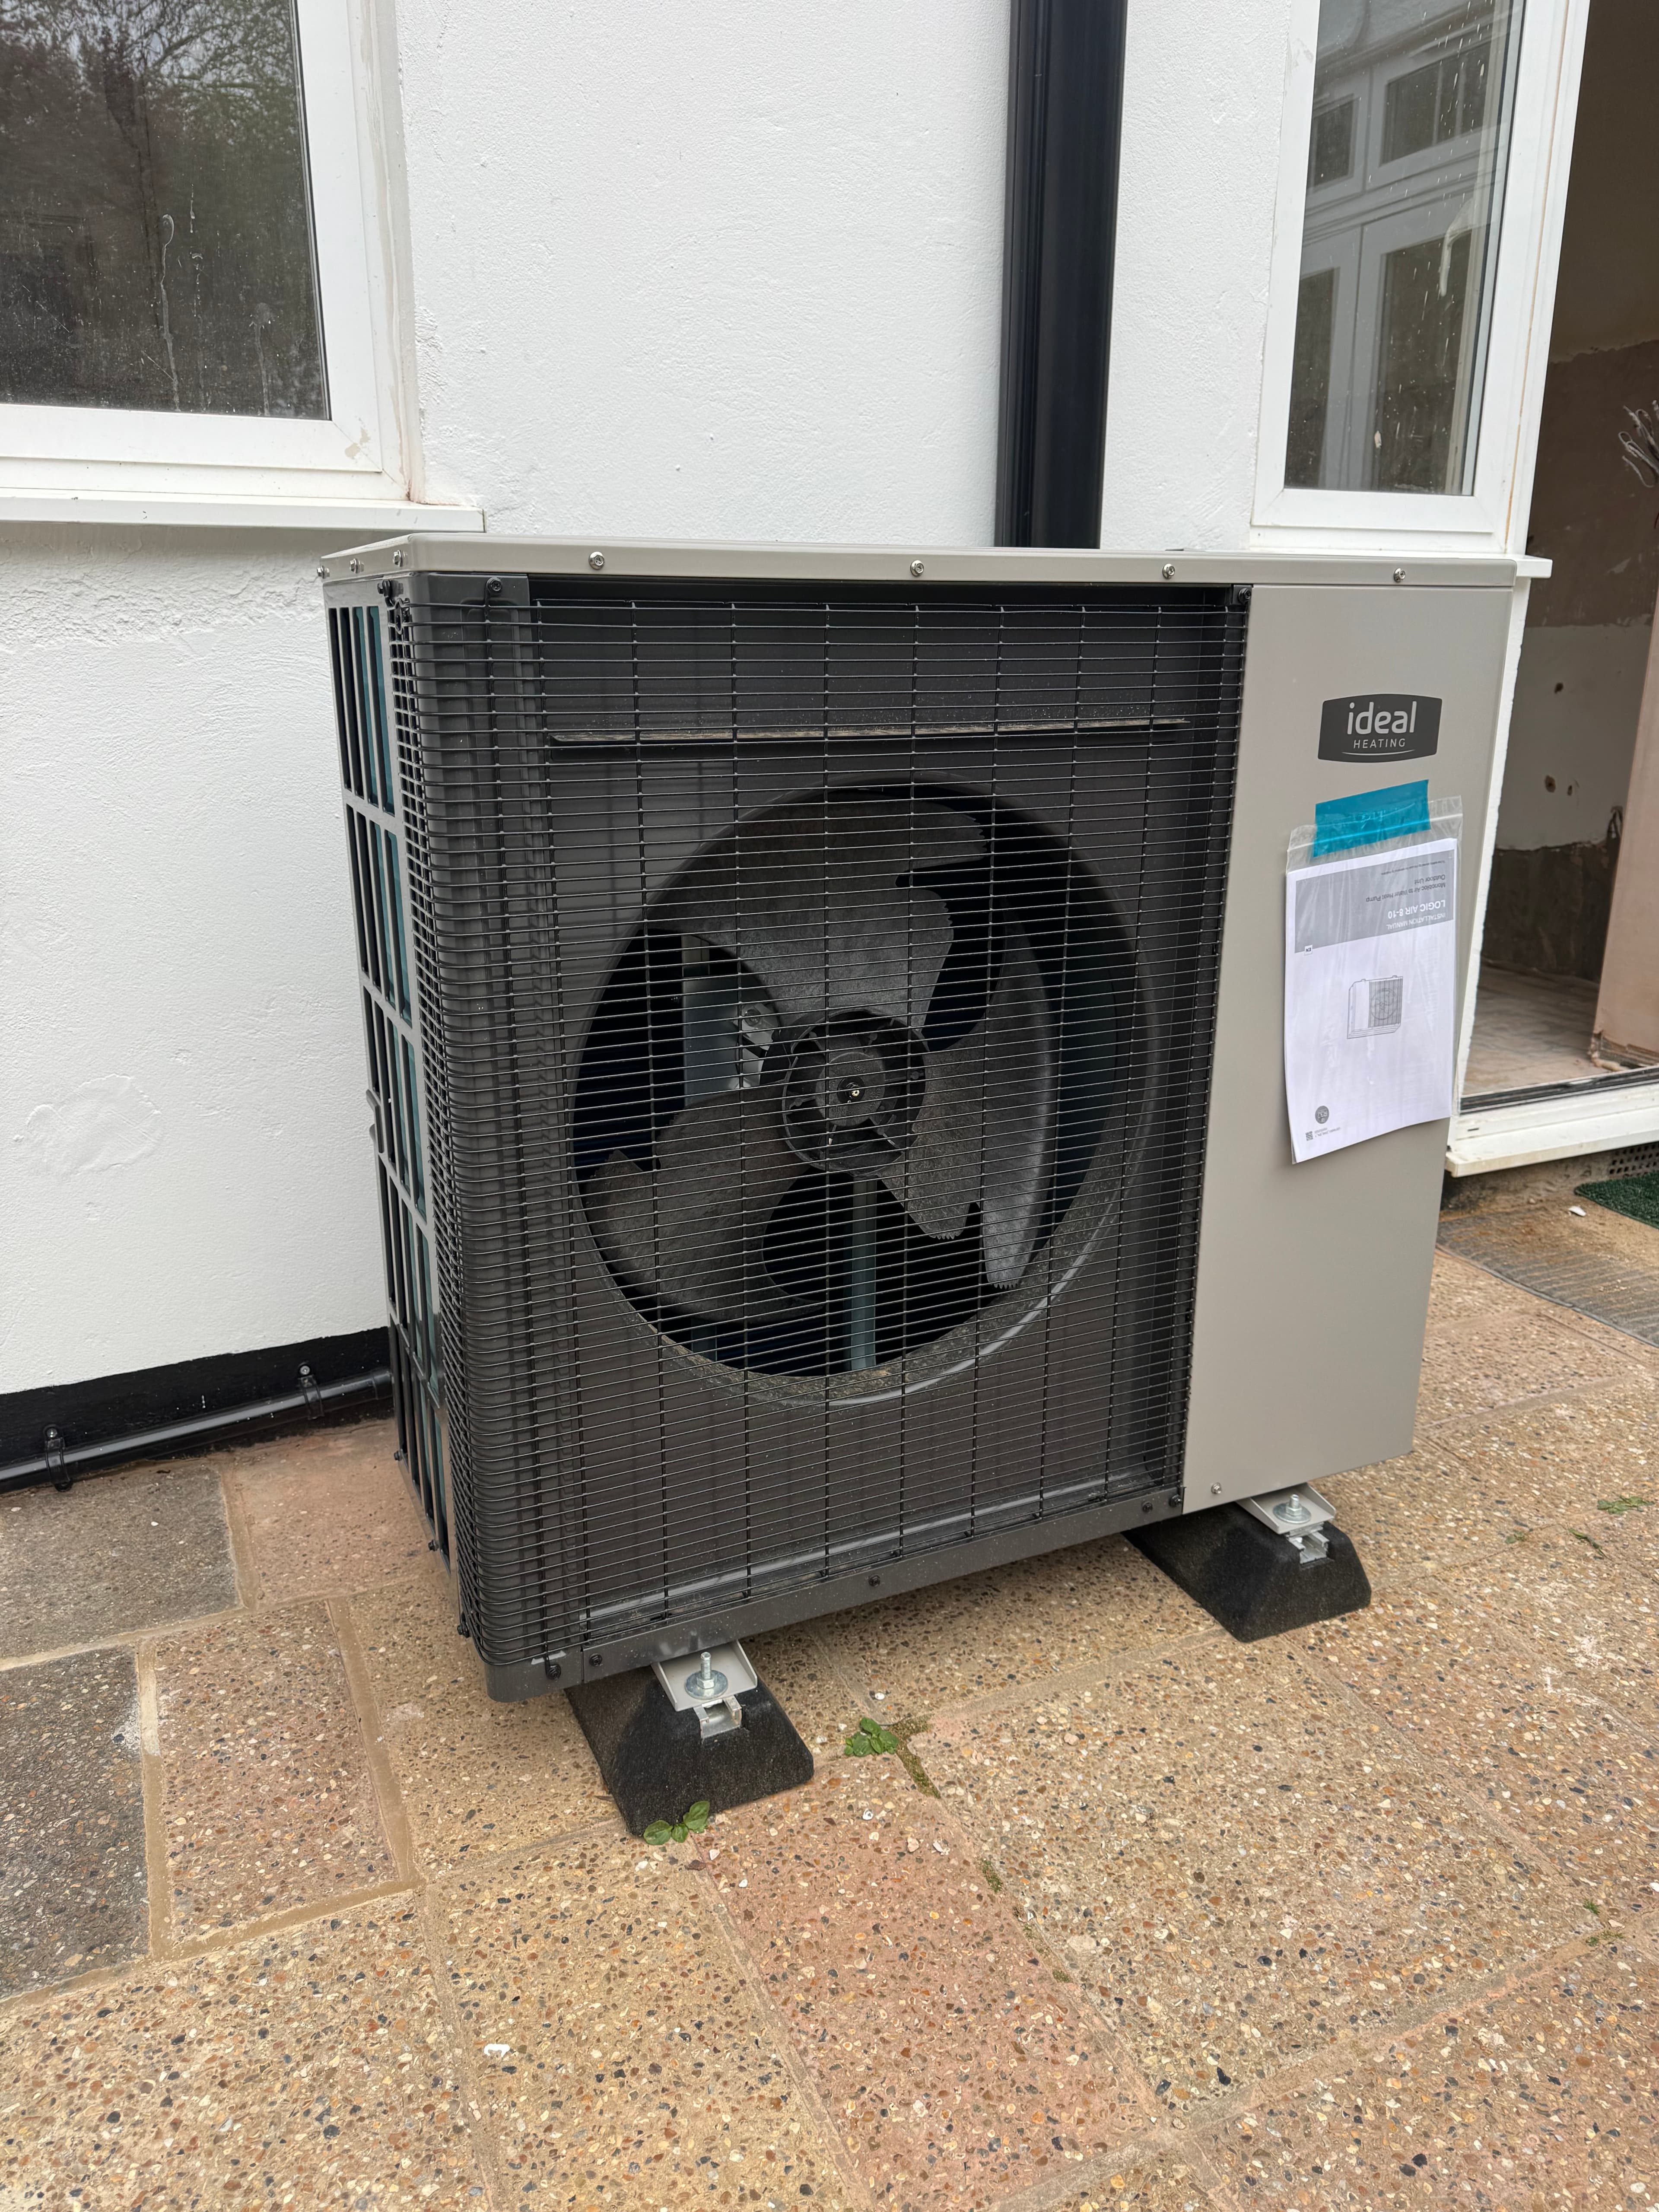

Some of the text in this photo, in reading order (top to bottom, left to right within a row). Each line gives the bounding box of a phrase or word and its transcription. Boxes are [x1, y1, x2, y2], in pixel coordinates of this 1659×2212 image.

[1348, 701, 1417, 734] ideal
[1354, 738, 1406, 749] HEATING
[1425, 874, 1446, 883] Outdoor
[1421, 883, 1446, 891] Monobloc
[1394, 890, 1408, 898] Water
[1388, 899, 1446, 919] LOGIC AIR 8-10
[1386, 913, 1446, 930] INSTALLATION MANUAL
